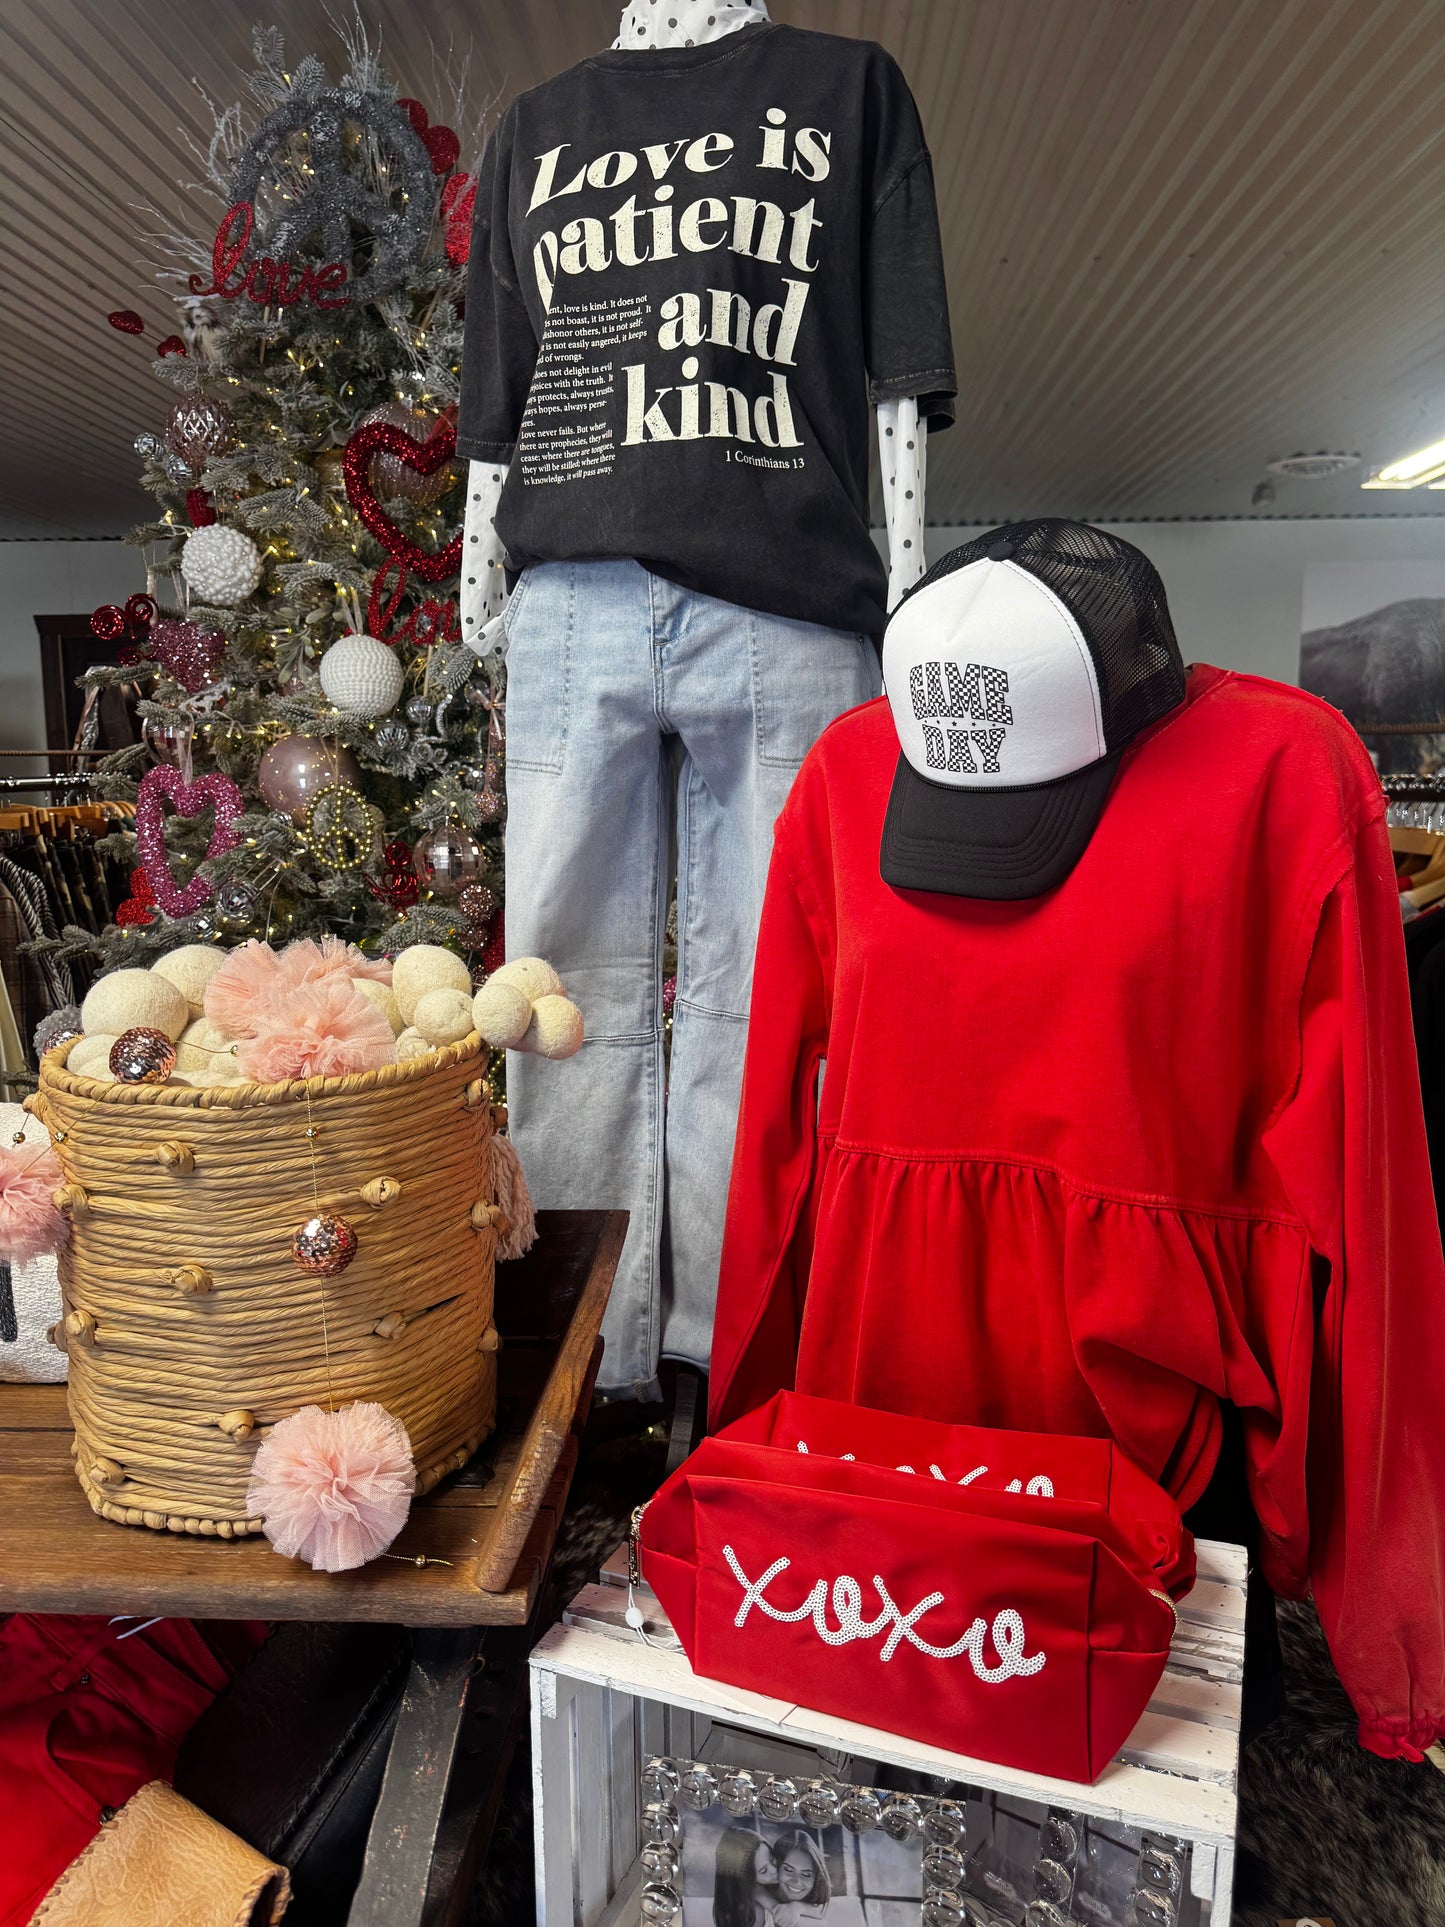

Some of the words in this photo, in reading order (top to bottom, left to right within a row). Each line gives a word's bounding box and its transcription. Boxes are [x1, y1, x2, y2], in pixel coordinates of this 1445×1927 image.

[525, 143, 734, 218] Love
[756, 107, 831, 182] is
[189, 200, 352, 310] love
[533, 184, 823, 315] patient
[564, 304, 579, 313] love
[590, 301, 608, 311] kind.
[610, 300, 615, 308] It
[617, 298, 634, 307] does
[636, 295, 647, 303] not
[567, 317, 589, 325] boast,
[591, 315, 597, 323] it
[620, 308, 642, 321] proud.
[646, 305, 651, 313] It
[658, 278, 810, 366] and
[575, 328, 600, 336] others,
[630, 318, 643, 328] self-
[568, 340, 589, 349] easily
[591, 335, 620, 348] angered,
[628, 330, 647, 340] keeps
[545, 353, 553, 362] of
[554, 353, 584, 362] wrongs.
[564, 366, 589, 376] delight
[592, 365, 599, 373] in
[600, 362, 612, 371] evil
[554, 379, 570, 388] with
[573, 378, 584, 386] the
[586, 376, 605, 385] truth.
[538, 393, 569, 404] protects,
[571, 390, 594, 399] always
[620, 356, 804, 448] kind
[539, 406, 562, 415] hopes,
[564, 403, 587, 412] always
[521, 431, 535, 439] Love
[538, 429, 557, 437] never
[559, 426, 575, 435] fails.
[551, 438, 588, 450] prophecies,
[589, 435, 601, 443] they
[522, 465, 537, 475] they
[538, 464, 550, 472] will
[582, 458, 599, 466] where
[600, 453, 615, 462] there
[542, 452, 562, 460] where
[564, 450, 580, 458] there
[725, 450, 730, 461] 1
[735, 450, 790, 468] Corinthians
[793, 458, 804, 468] 13
[531, 474, 565, 484] knowledge,
[572, 470, 582, 479] will
[583, 470, 596, 479] pass
[597, 466, 613, 474] away.
[910, 662, 1013, 725] GAME
[922, 724, 1006, 773] DAY
